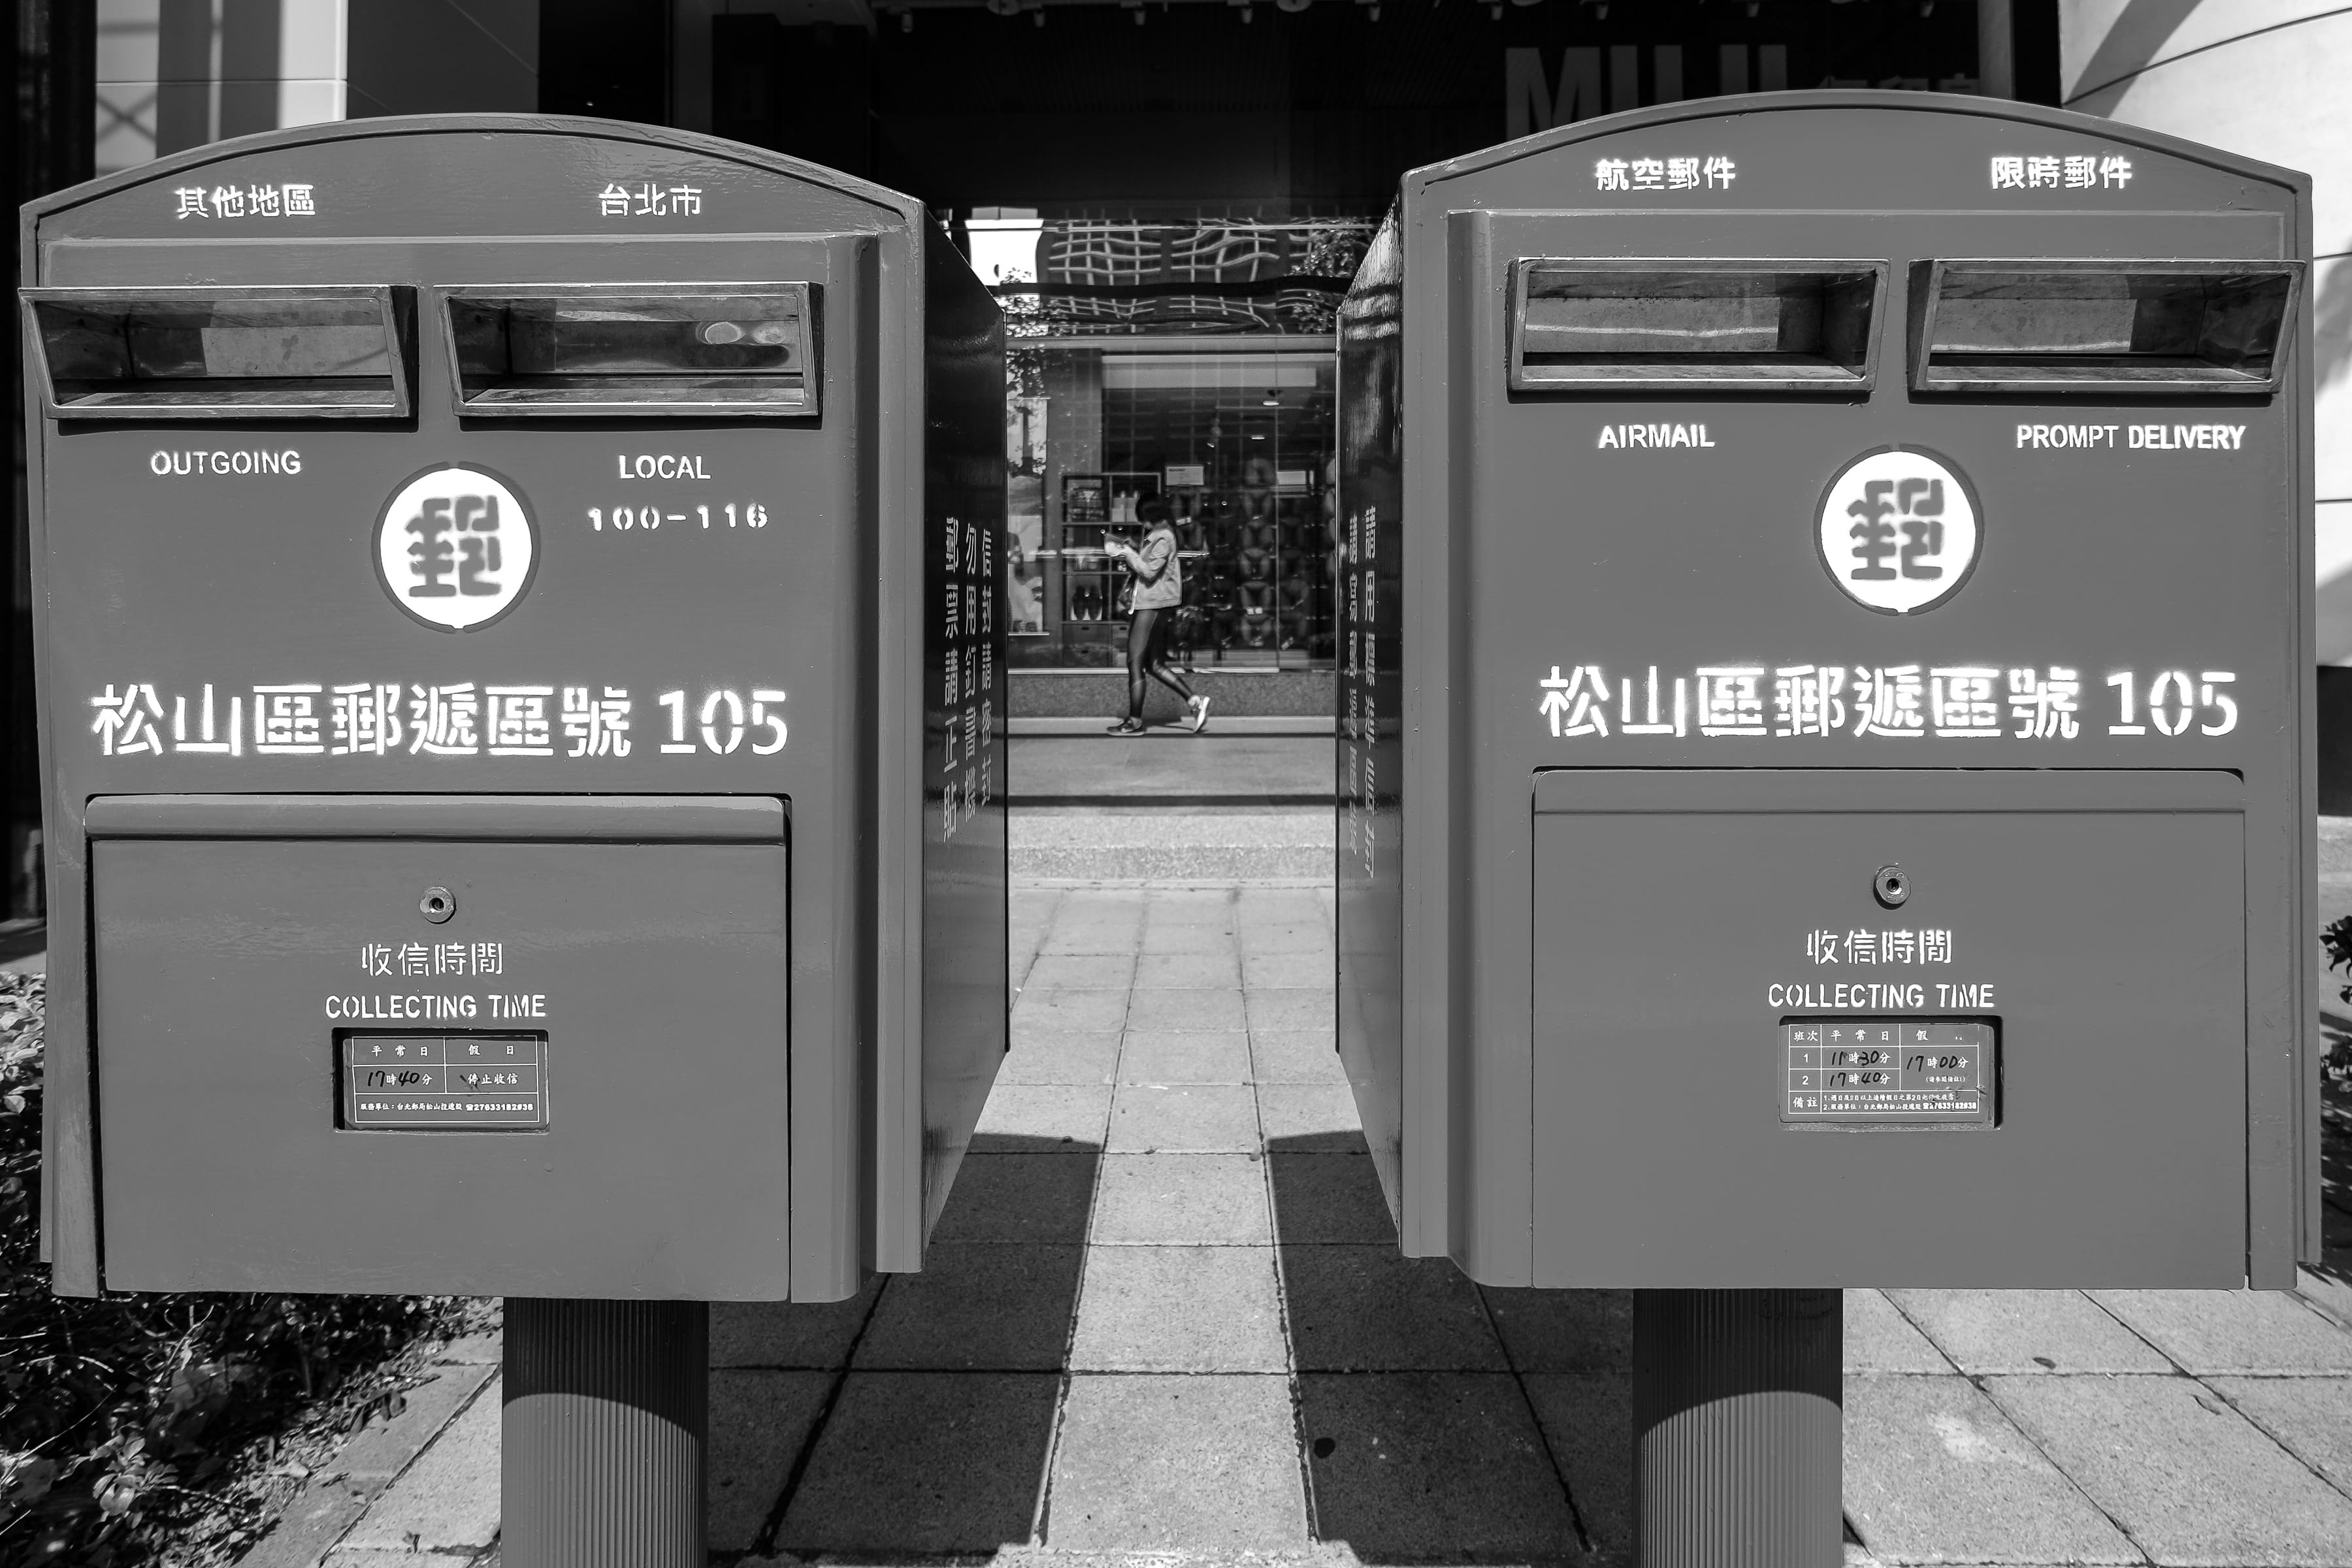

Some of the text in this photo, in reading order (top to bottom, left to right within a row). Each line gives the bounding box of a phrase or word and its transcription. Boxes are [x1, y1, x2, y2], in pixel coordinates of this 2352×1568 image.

[1595, 157, 1736, 191] 航空郵件
[1991, 156, 2132, 189] 限時郵件
[175, 184, 316, 220] 其他地區
[598, 183, 702, 216] 台北市
[1598, 424, 1715, 449] AIRMAIL
[2017, 425, 2246, 450] PROMPT DELIVERY
[151, 451, 301, 476] OUTGOING
[619, 455, 711, 480] LOCAL
[587, 503, 768, 531] 100-116
[943, 517, 959, 843] 郵票請正貼
[964, 523, 977, 823] 勿用釘書機
[981, 528, 992, 807] 信封請密封
[1364, 505, 1376, 879] 請用標準信封
[1539, 664, 2238, 740] 松山區郵遞區號 105
[90, 682, 788, 757] 松山區郵遞區號 105
[361, 941, 502, 977] 收信時間
[1806, 928, 1952, 965] 收信時間
[325, 994, 547, 1019] COLLECTING TIME
[1768, 983, 1995, 1009] COLLECTING TIME
[1793, 1030, 1818, 1041] 班次
[1830, 1029, 1889, 1041] 平常日
[371, 1045, 429, 1057] 平常日
[468, 1044, 515, 1056] 假日
[1803, 1053, 1808, 1063] 1
[467, 1073, 519, 1085] 停止收信
[1802, 1075, 1809, 1085] 2
[1793, 1096, 1818, 1109] 備註
